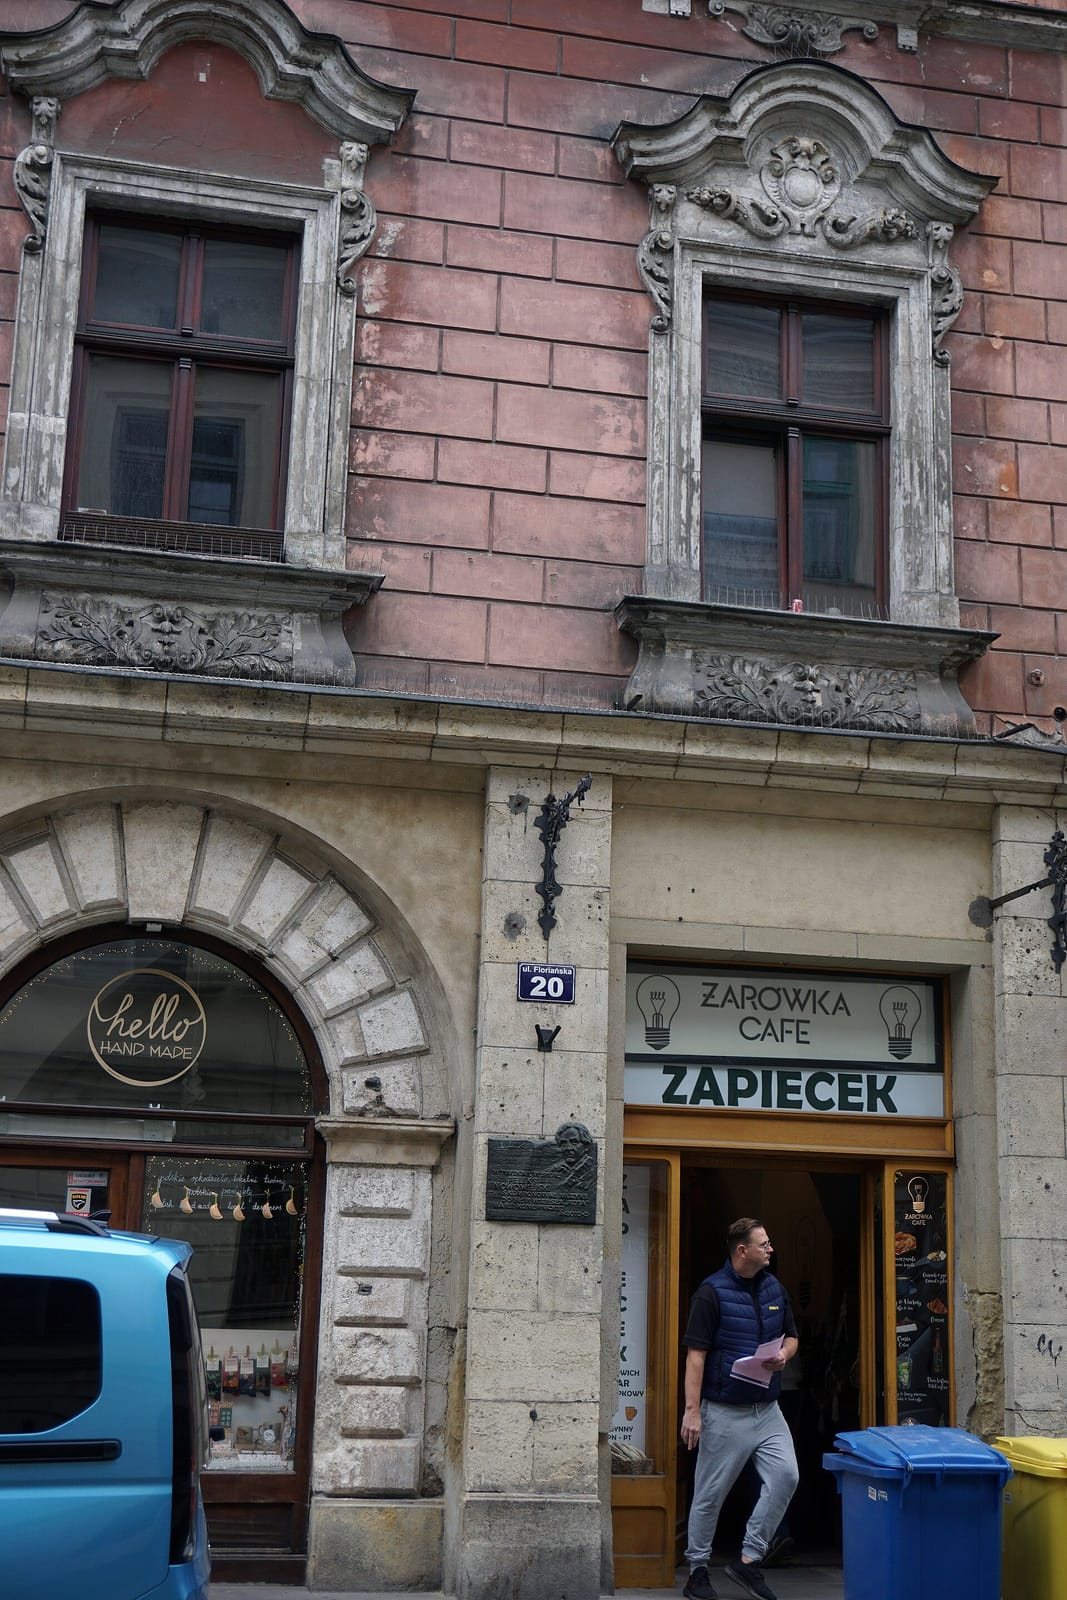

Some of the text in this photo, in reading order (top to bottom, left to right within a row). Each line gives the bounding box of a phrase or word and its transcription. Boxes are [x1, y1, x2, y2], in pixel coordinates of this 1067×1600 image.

[533, 966, 573, 975] Floriańska
[530, 976, 564, 997] 20
[97, 993, 202, 1042] hello
[739, 1016, 811, 1045] CAFE
[100, 1041, 193, 1060] HAND MADE
[661, 1065, 898, 1113] ZAPIECEK
